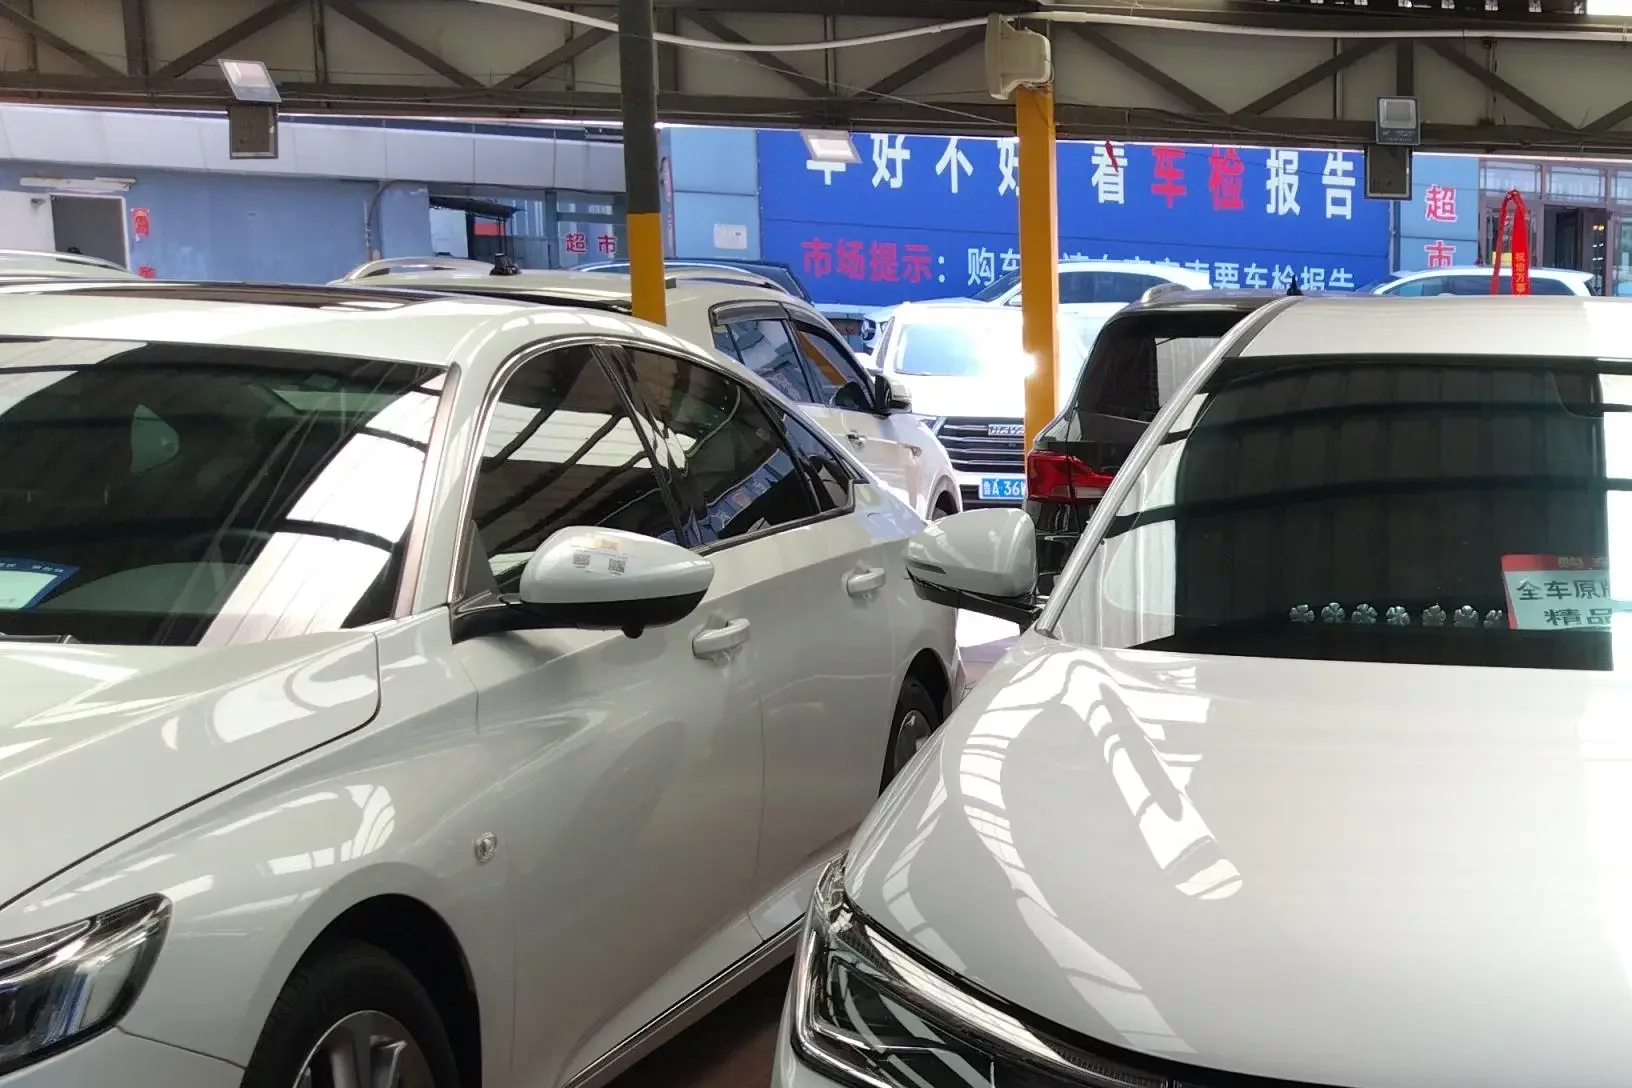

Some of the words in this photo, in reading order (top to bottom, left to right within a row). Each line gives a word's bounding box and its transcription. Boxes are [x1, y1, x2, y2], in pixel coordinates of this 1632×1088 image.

[1091, 143, 1356, 219] 看车检报告
[565, 231, 617, 255] 超市
[1424, 184, 1457, 268] 超市
[988, 424, 1025, 436] HAVA
